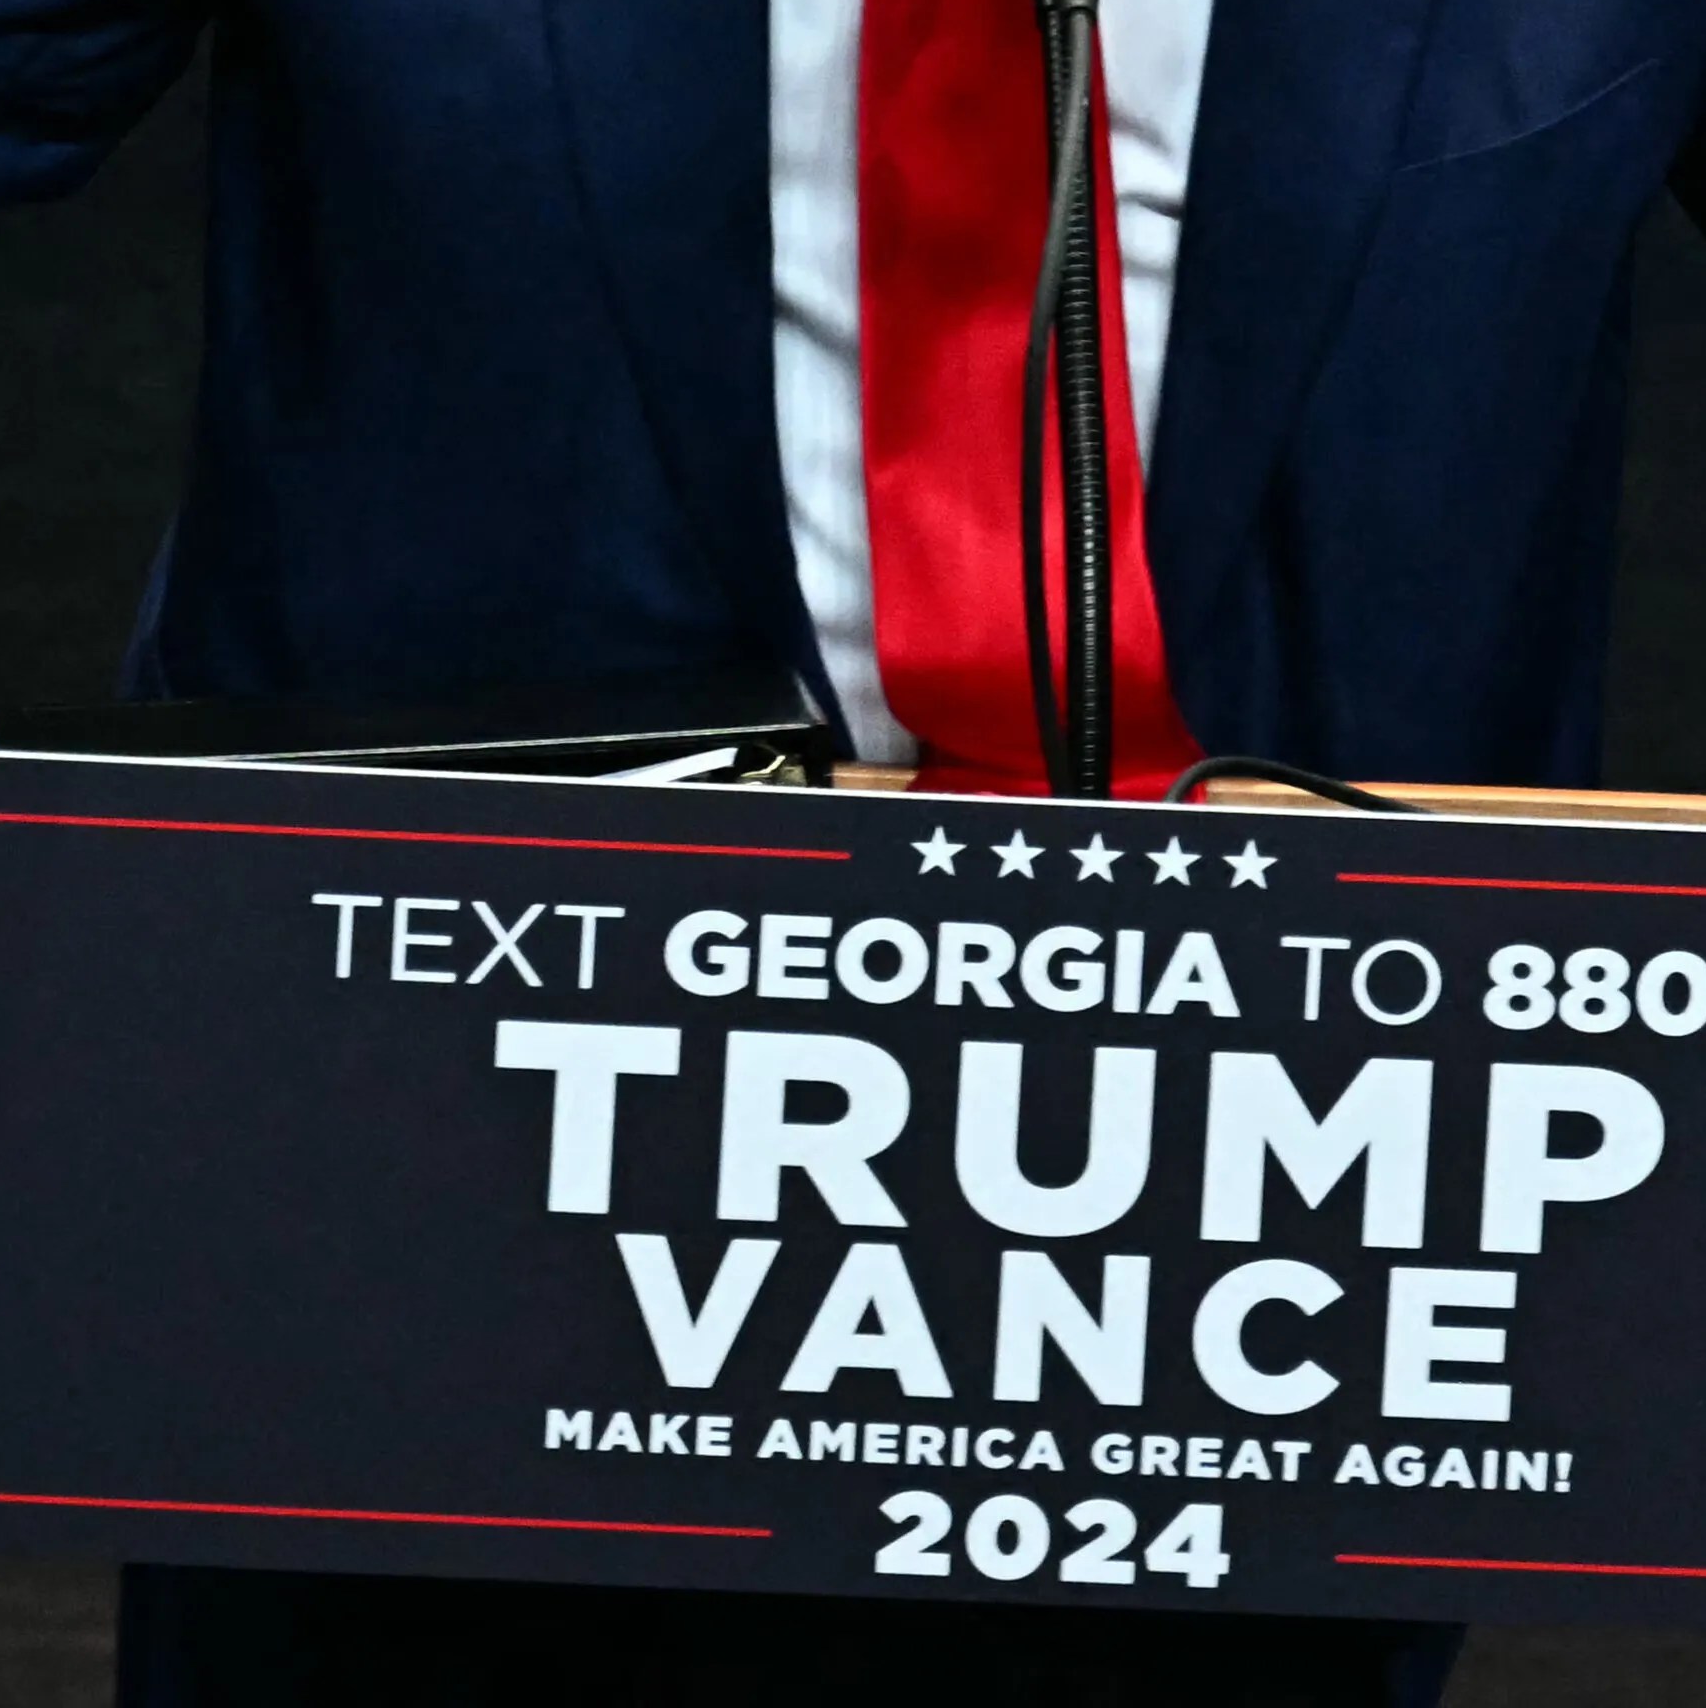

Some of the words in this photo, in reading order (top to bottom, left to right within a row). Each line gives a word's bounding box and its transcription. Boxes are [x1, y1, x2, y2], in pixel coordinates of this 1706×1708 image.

[311, 893, 626, 990] TEXT
[663, 909, 1241, 1018] GEORGIA
[1280, 935, 1442, 1026] TO
[494, 1019, 1665, 1254] TRUMP
[614, 1232, 1518, 1422] VANCE
[544, 1408, 733, 1457] MAKE
[756, 1418, 1065, 1472] AMERICA
[1091, 1432, 1312, 1482] GREAT
[1333, 1443, 1573, 1493] AGAIN!
[874, 1490, 1231, 1589] 2024
